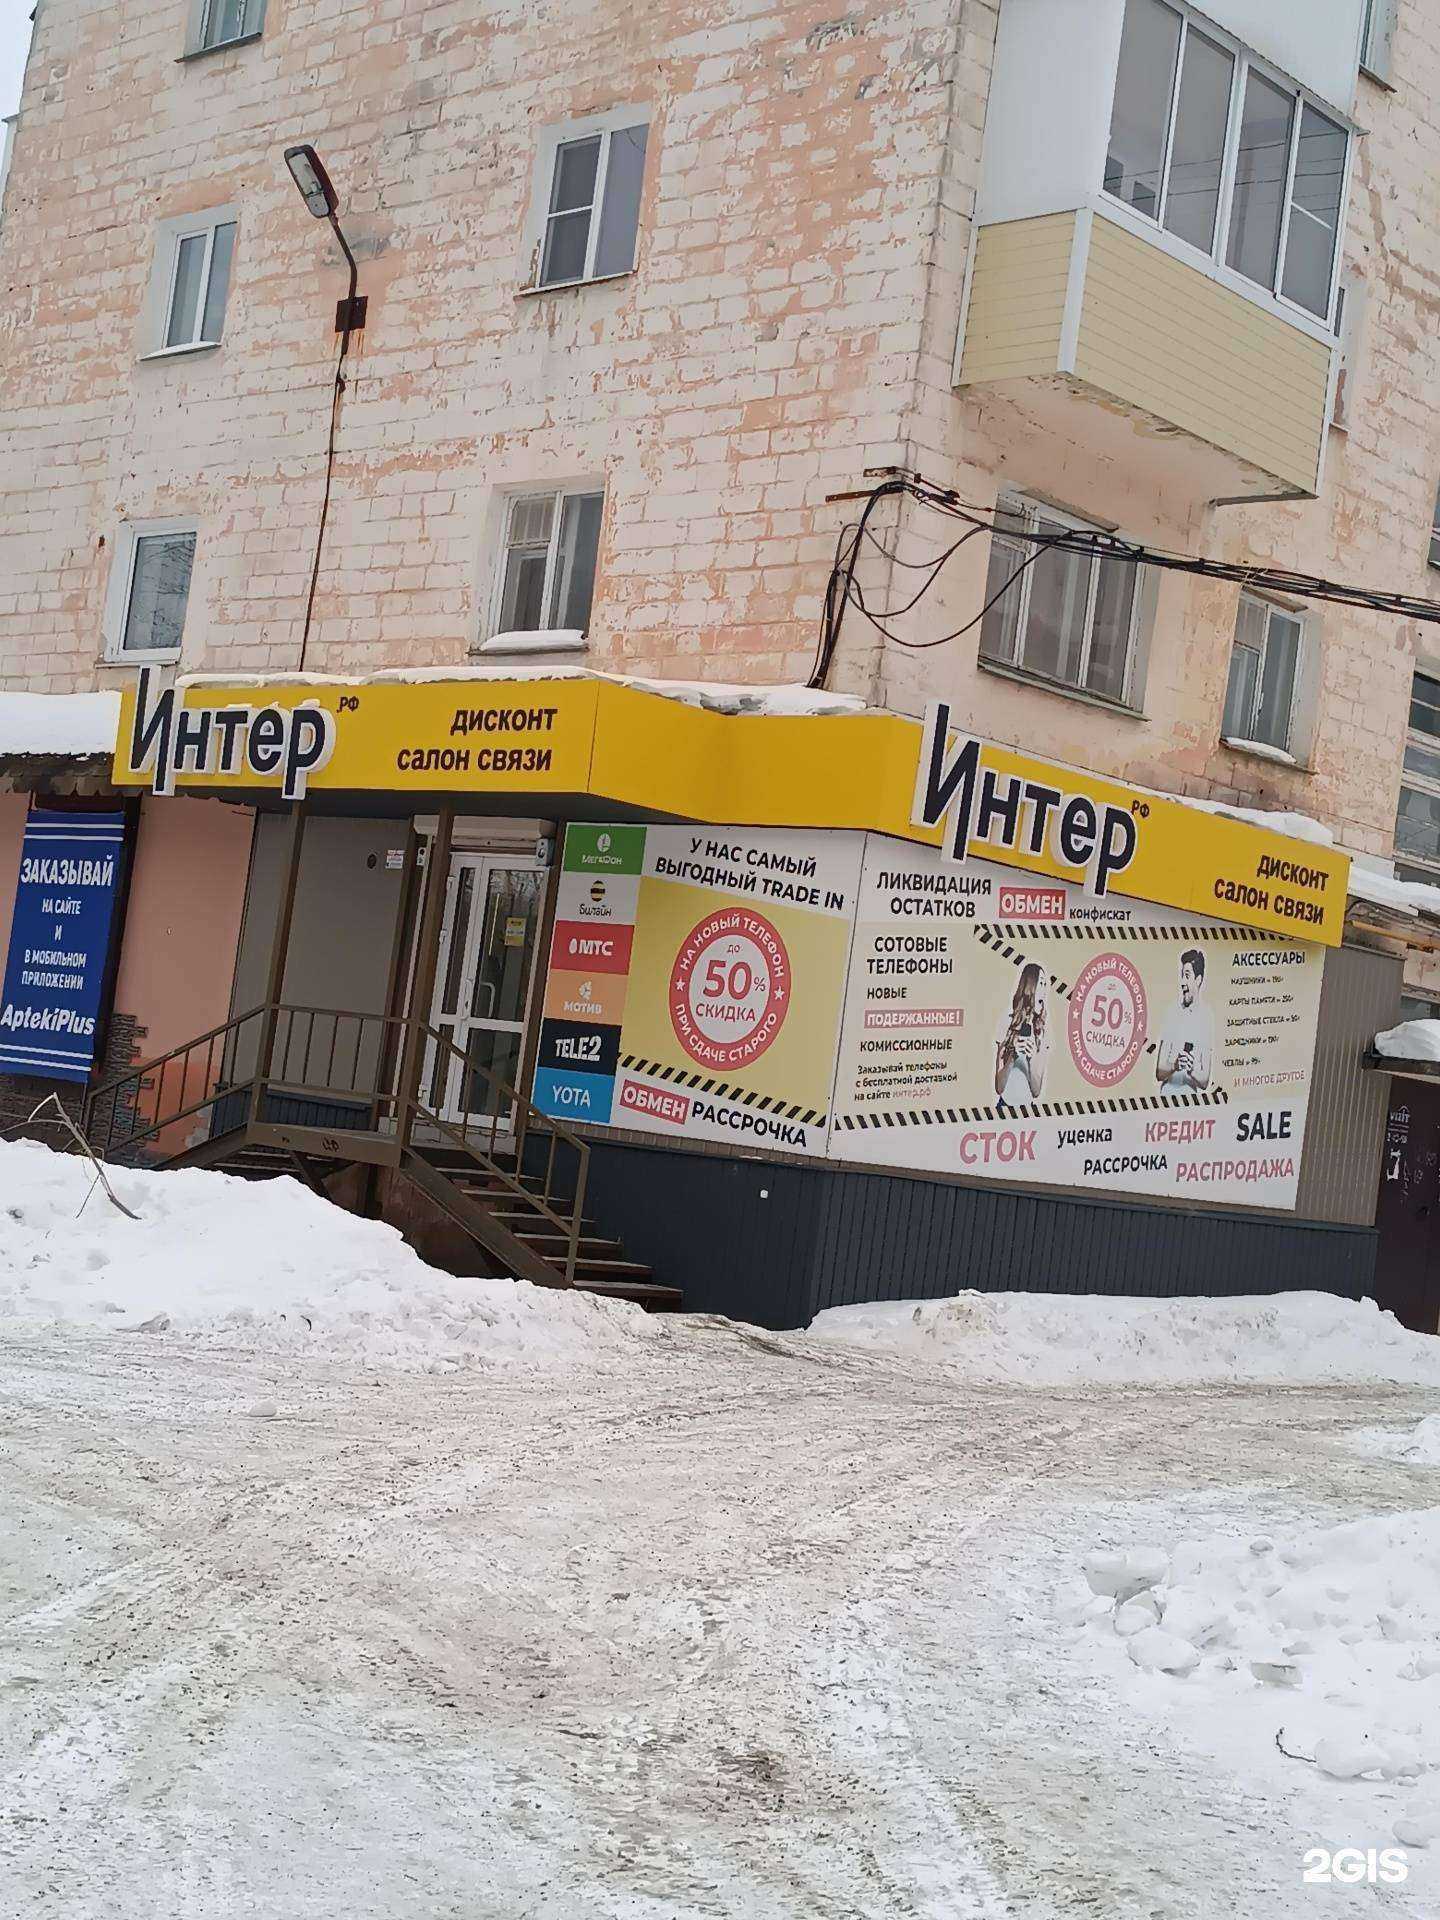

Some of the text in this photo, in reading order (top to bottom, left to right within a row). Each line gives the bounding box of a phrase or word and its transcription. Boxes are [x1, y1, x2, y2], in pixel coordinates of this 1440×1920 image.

[396, 748, 553, 771] салон связи
[690, 838, 817, 877] У НАС САМЫЙ
[20, 855, 114, 887] ЗАКАЗЫВАЙ
[655, 857, 844, 911] ВЫГОДНЫЙ TRADE IN
[877, 871, 992, 898] ЛИКВИДАЦИЯ
[42, 896, 82, 915] НА САЙТЕ
[890, 897, 976, 918] ОСТАТКОВ
[1000, 892, 1064, 915] ОБМЕН
[1214, 878, 1324, 925] салон связи
[1069, 906, 1132, 922] конфискат
[54, 925, 62, 941] И
[578, 938, 614, 957] МТС
[680, 912, 785, 978] НА НОВЫЙ ТЕЛЕФОН
[874, 936, 948, 953] СОТОВЫЕ
[25, 949, 87, 968] В МОБИЛЬНОМ
[866, 958, 953, 975] ТЕЛЕФОНЫ
[1232, 951, 1306, 967] АКСЕССУАРЫ
[22, 971, 84, 990] ПРИЛОЖЕНИИ
[1085, 957, 1118, 984] НОВЫЙ
[866, 986, 908, 999] НОВЫЕ
[0, 1004, 96, 1035] AptekiPlus
[695, 1003, 756, 1022] СКИДКА
[675, 1003, 777, 1062] ПРИ СДАЧЕ СТАРОГО
[1085, 1030, 1125, 1048] СКИДКА
[555, 1035, 602, 1061] TELE2
[860, 1038, 953, 1052] КОМИССИОННЫЕ
[1080, 1056, 1106, 1080] СДАЧЕ
[862, 1075, 913, 1087] бесплатной
[552, 1085, 591, 1107] YOTA
[622, 1085, 687, 1119] ОБМЕН
[854, 1093, 865, 1101] на
[866, 1090, 891, 1100] сайте
[692, 1101, 808, 1148] РАССРОЧКА
[1144, 1119, 1216, 1143] КРЕДИТ
[1235, 1111, 1293, 1141] SALE
[959, 1129, 1038, 1164] СТОК
[1057, 1127, 1113, 1148] уценка
[1083, 1154, 1168, 1176] РАССРОЧКА
[1175, 1157, 1295, 1183] РАСПРОДАЖА
